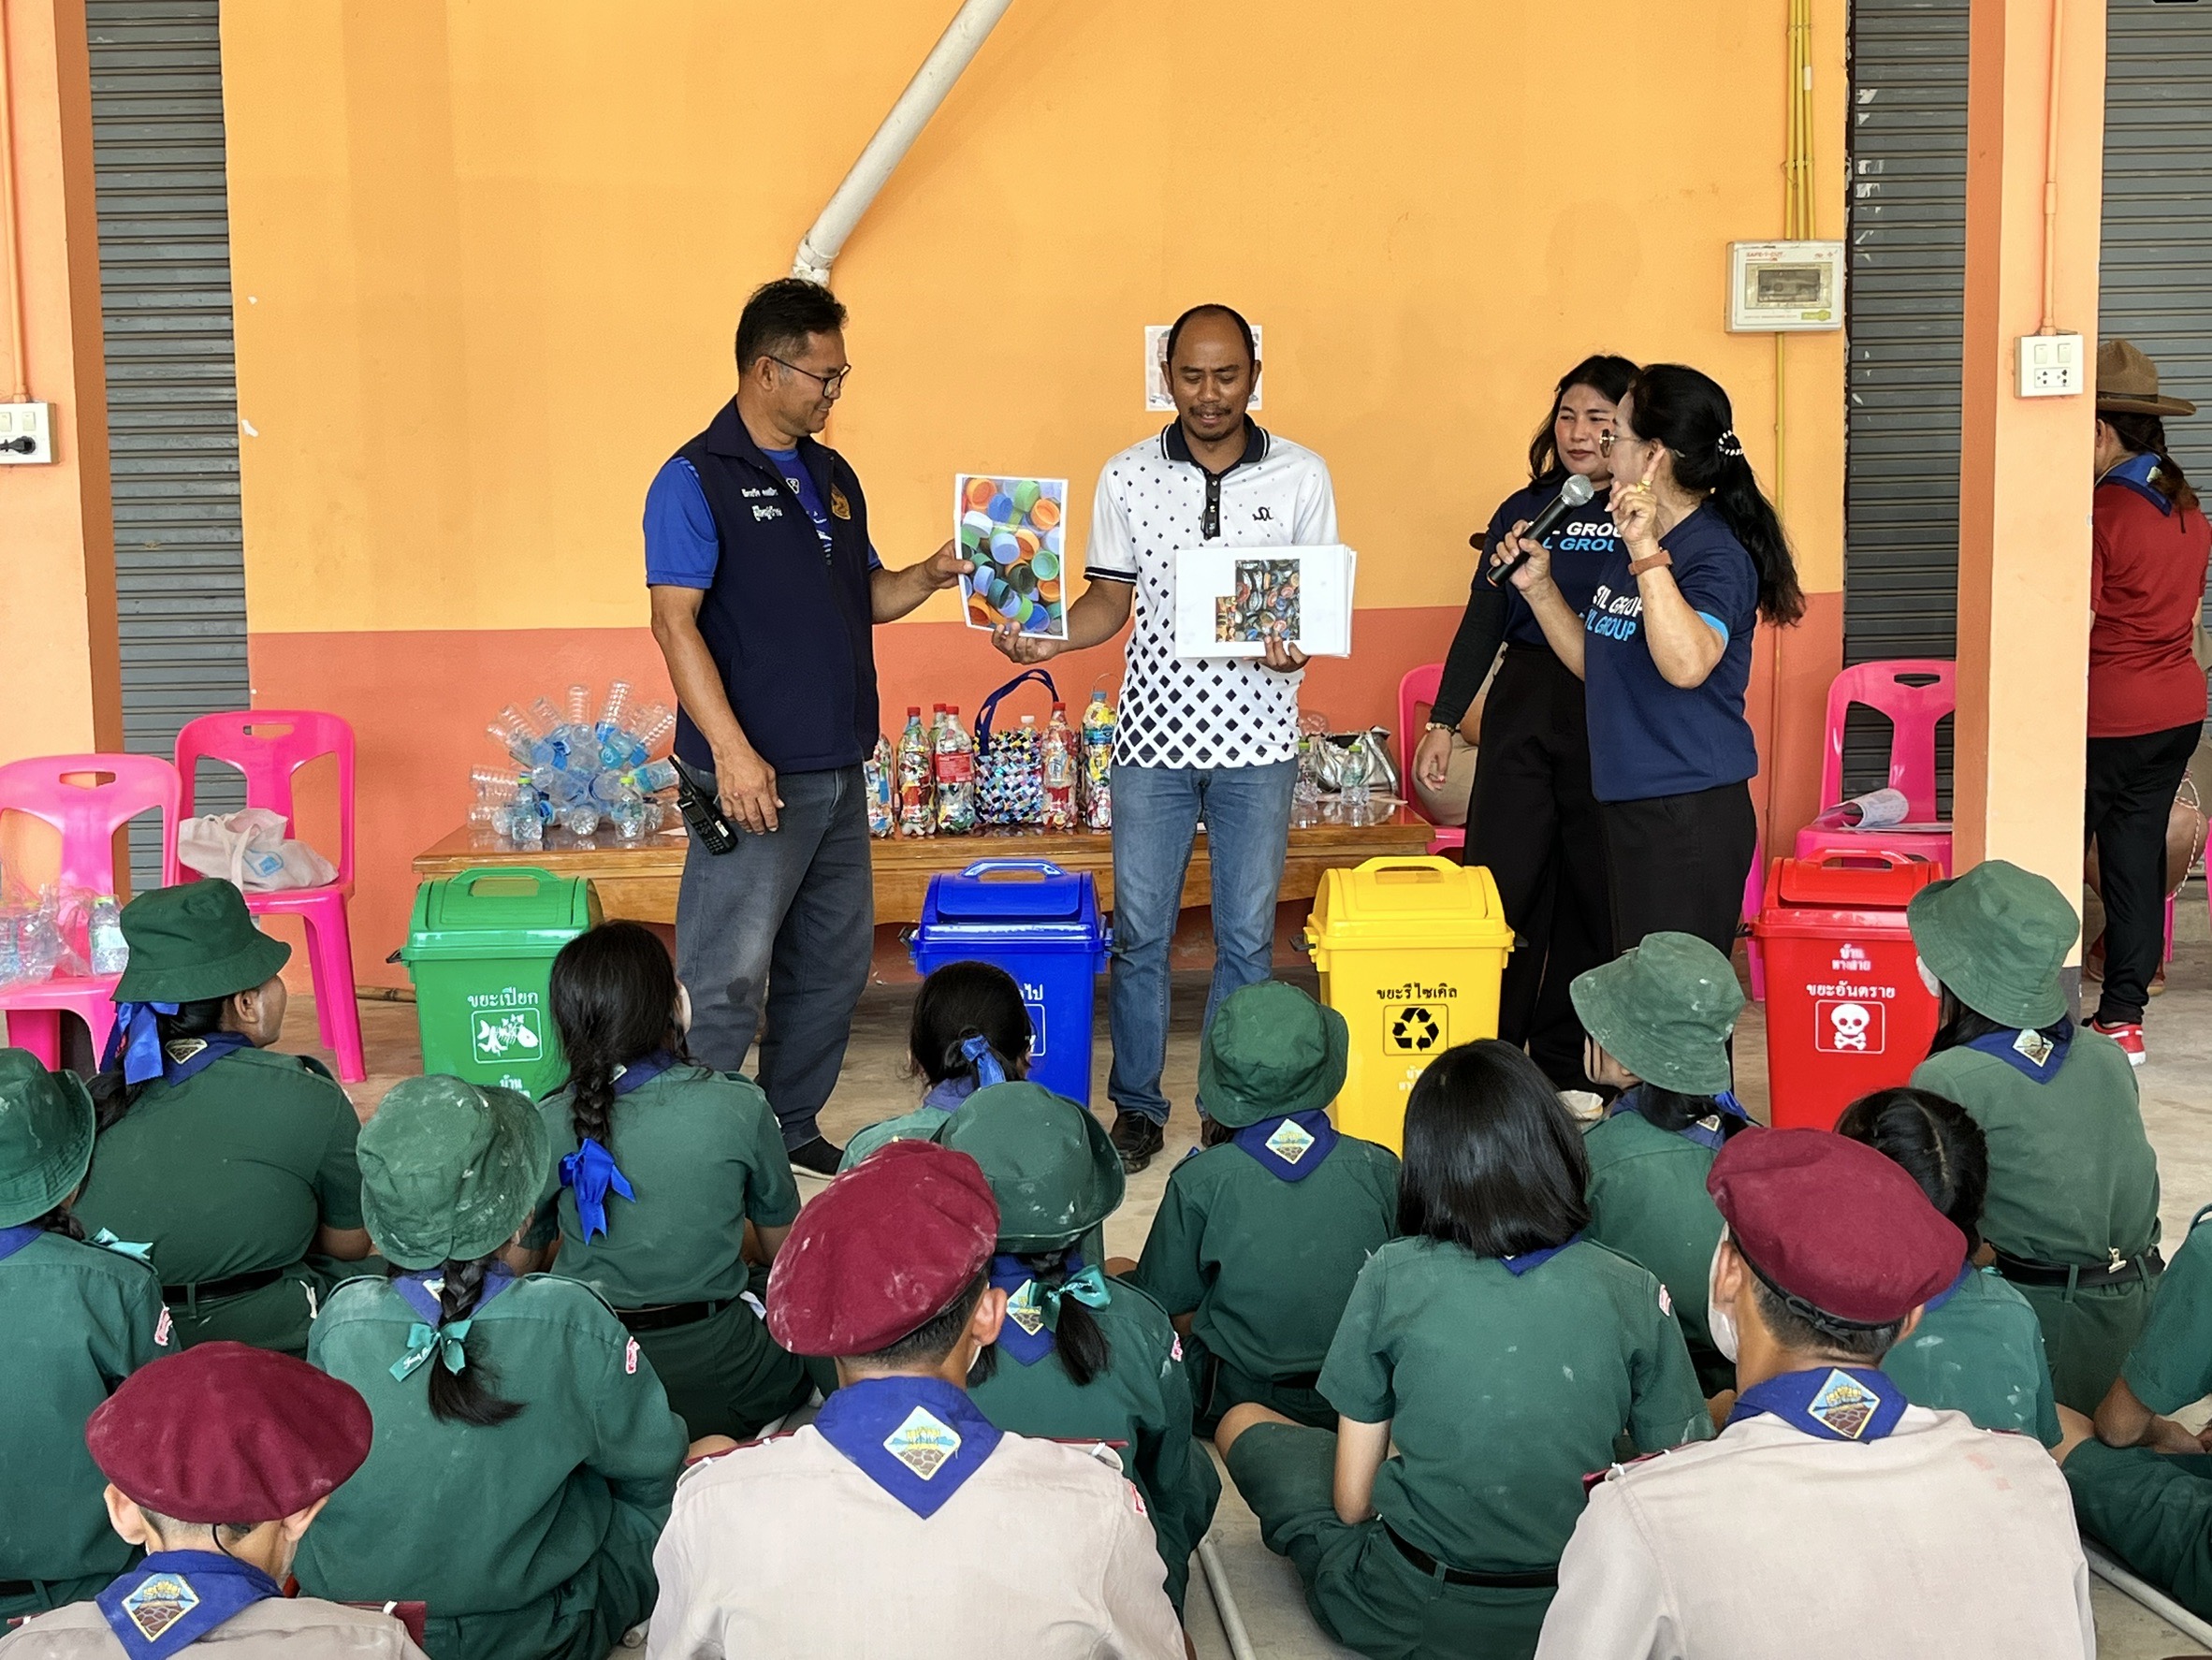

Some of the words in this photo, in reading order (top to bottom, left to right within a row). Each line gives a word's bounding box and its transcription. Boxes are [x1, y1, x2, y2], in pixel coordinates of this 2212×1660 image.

[1566, 522, 1622, 537] GROU
[1560, 538, 1614, 552] GRO
[1593, 585, 1611, 609] SIL
[1594, 616, 1637, 641] GROUP
[467, 986, 539, 1008] ขยะเปียก
[1806, 981, 1896, 998] ขยะอันตราย
